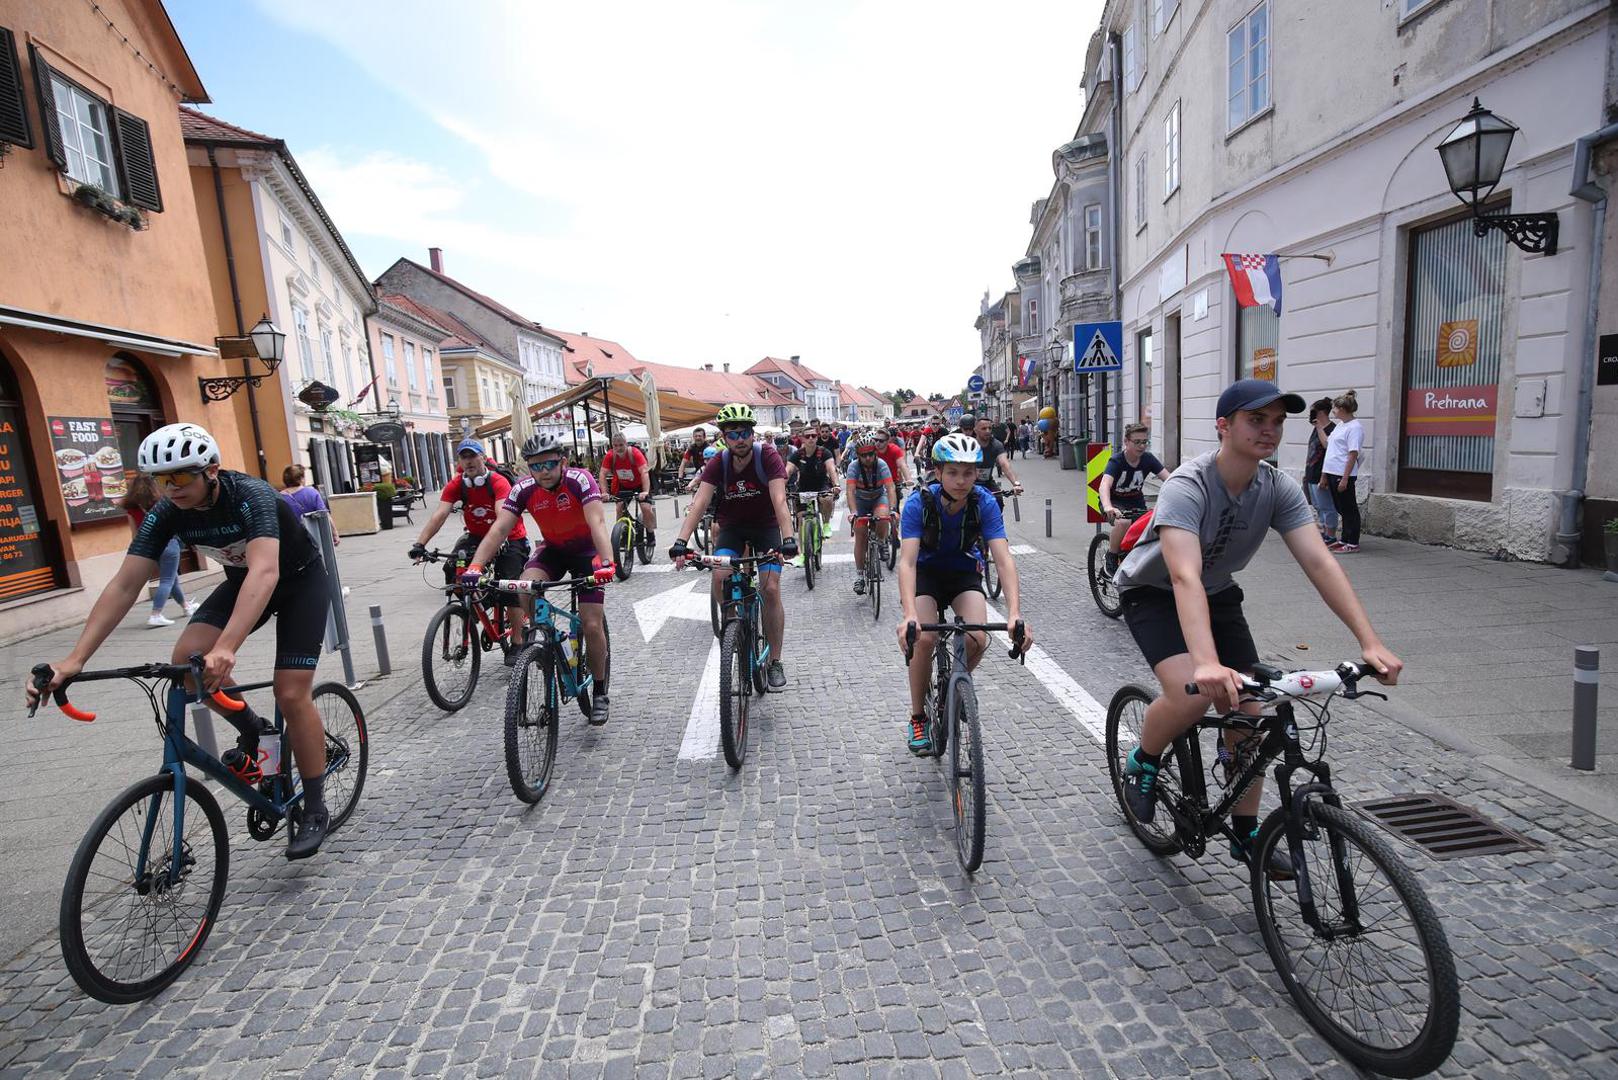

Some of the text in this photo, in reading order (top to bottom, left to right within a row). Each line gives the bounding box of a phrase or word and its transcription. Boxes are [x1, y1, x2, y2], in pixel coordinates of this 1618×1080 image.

[1425, 392, 1488, 409] Prehrana
[68, 421, 96, 432] FAST
[71, 432, 99, 443] FOOD
[1115, 470, 1144, 492] LA
